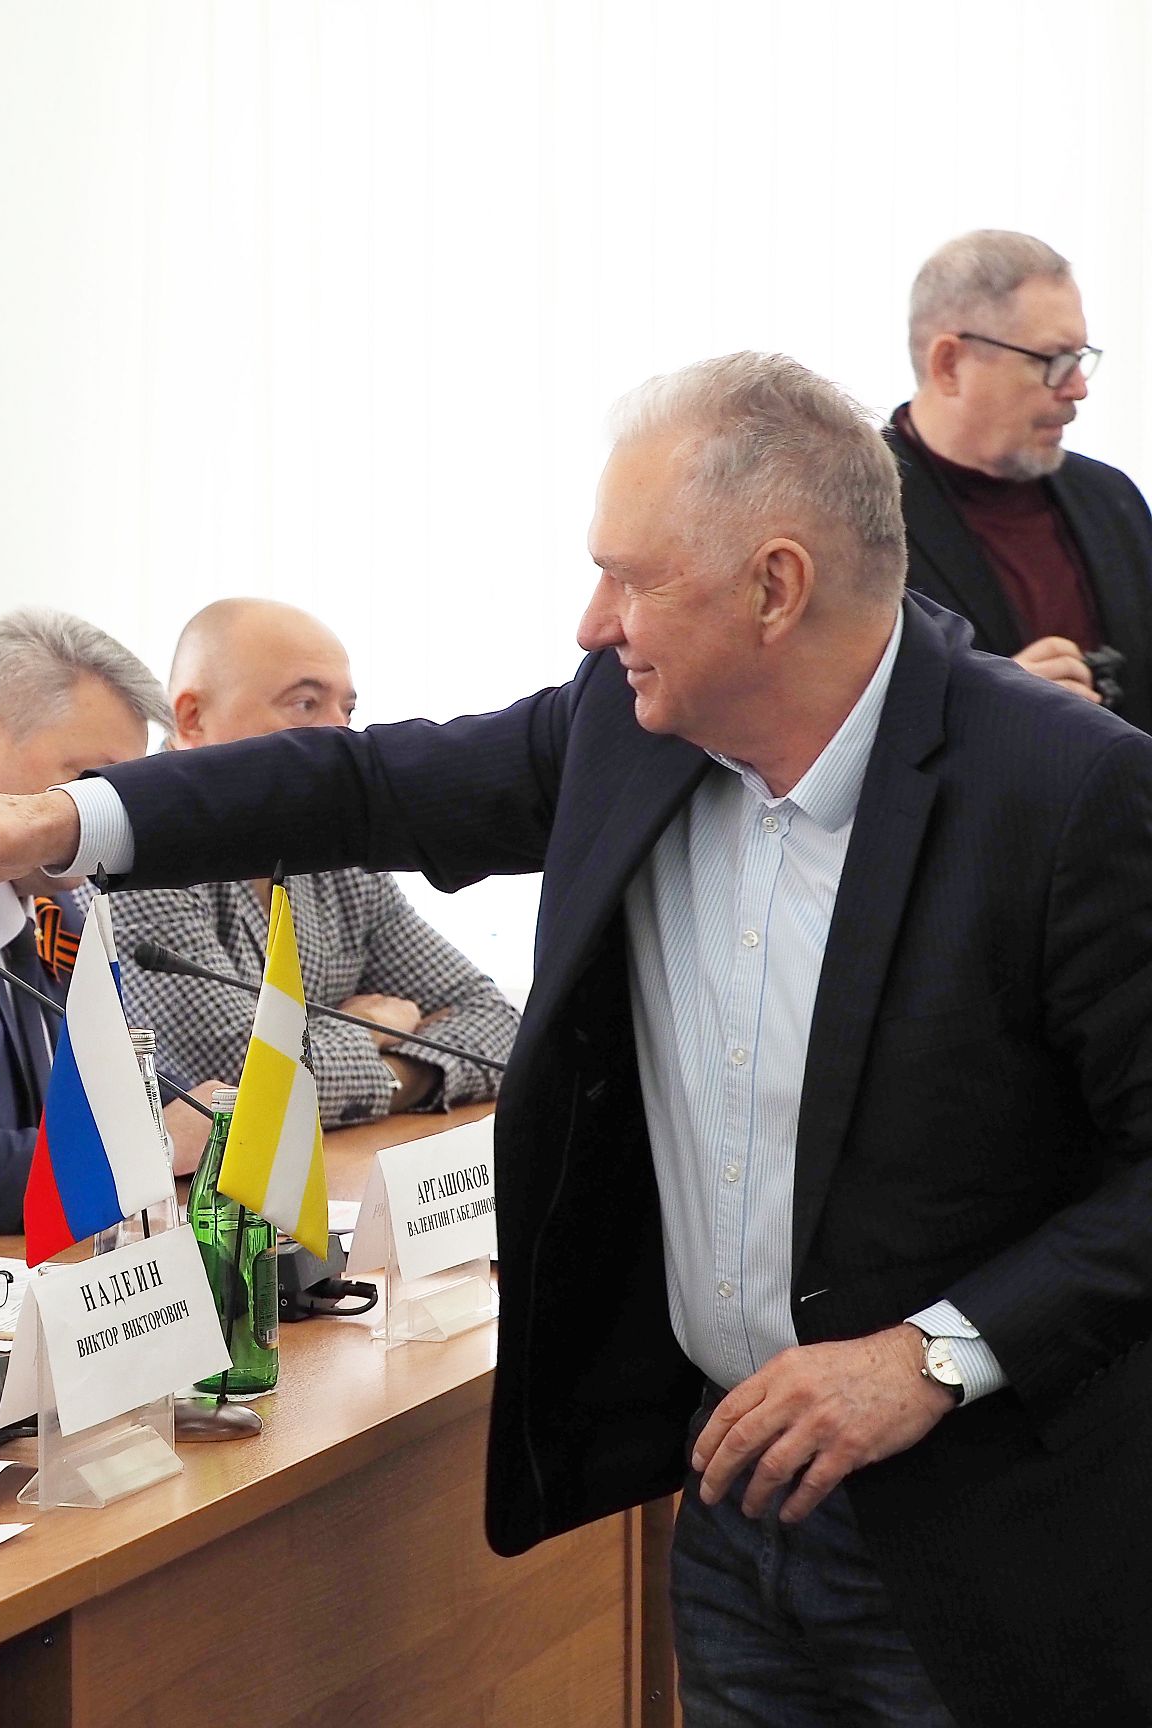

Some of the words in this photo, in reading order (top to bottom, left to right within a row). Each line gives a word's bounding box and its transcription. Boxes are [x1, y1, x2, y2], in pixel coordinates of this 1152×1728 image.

[416, 1164, 490, 1205] АРГАШОКОВ
[406, 1208, 451, 1237] ВАЛЕНТИН
[79, 1259, 164, 1312] НАДЕИН
[76, 1326, 119, 1358] ВИКТОР
[121, 1299, 190, 1341] ВИКТОРОВИЧ
